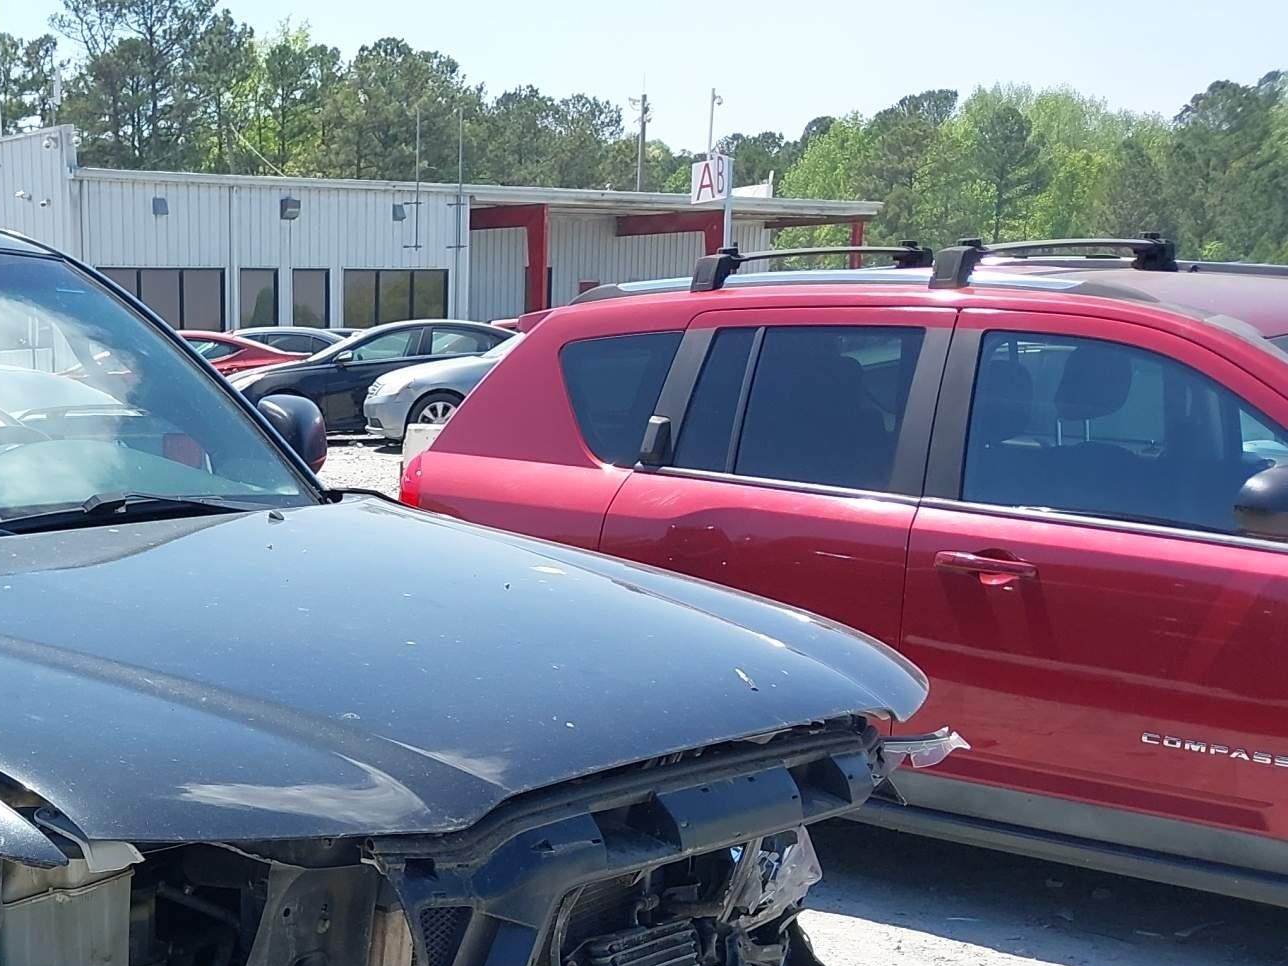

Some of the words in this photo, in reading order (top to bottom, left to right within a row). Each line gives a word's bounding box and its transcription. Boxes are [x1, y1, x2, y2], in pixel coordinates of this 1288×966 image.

[696, 163, 715, 201] A
[717, 156, 725, 193] B
[1141, 732, 1288, 767] COMPASS
